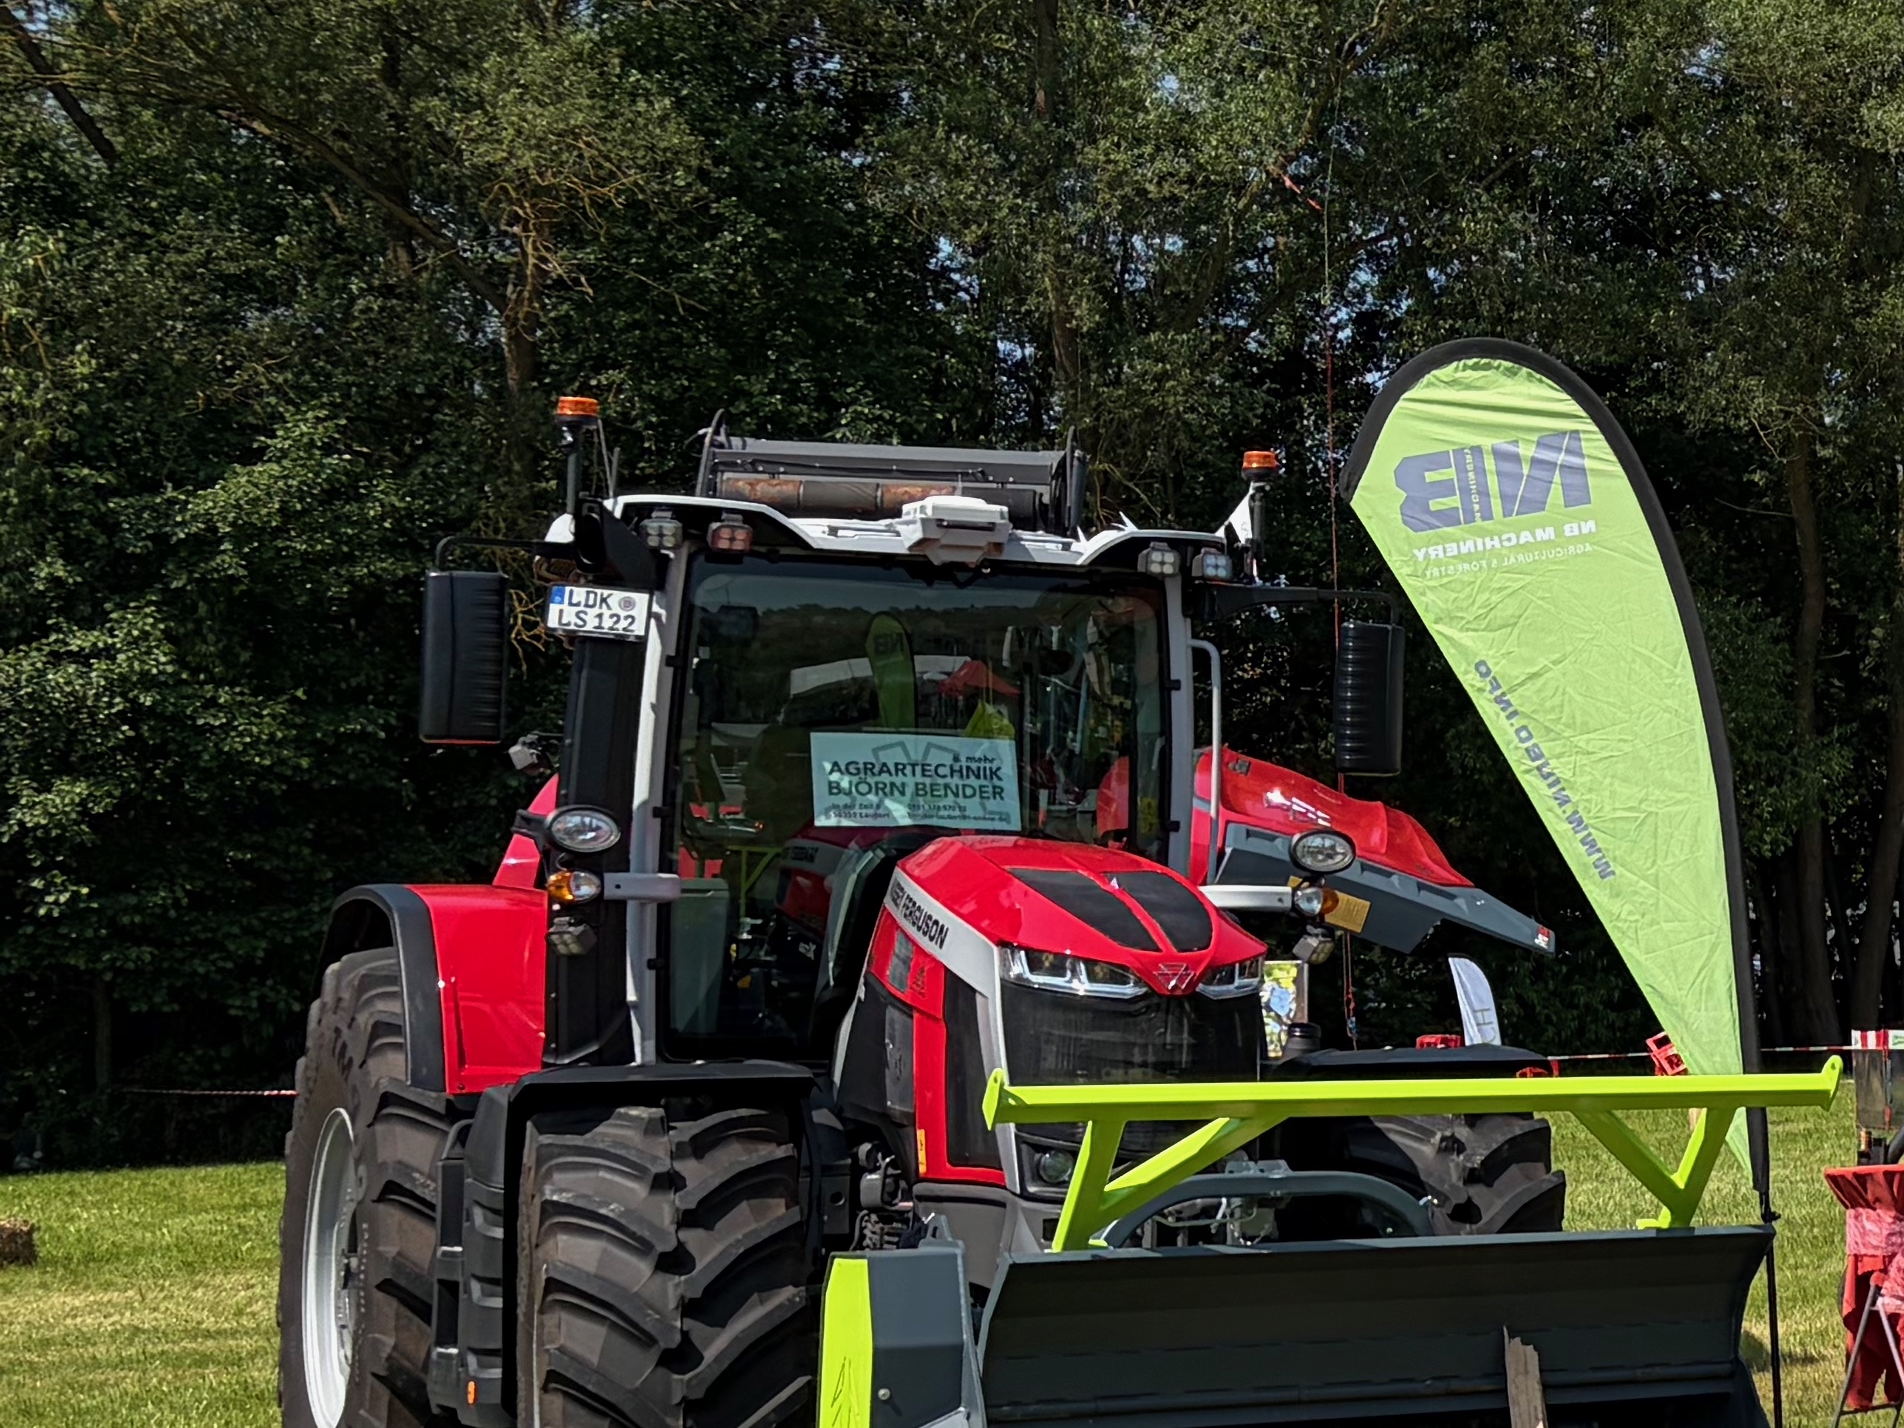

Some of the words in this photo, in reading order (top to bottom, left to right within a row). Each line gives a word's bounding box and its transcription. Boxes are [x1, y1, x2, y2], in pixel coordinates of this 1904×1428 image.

[567, 588, 614, 611] LDK
[557, 608, 589, 629] LS
[592, 612, 636, 633] 122
[828, 760, 1004, 782] AGRARTECHNIK
[965, 754, 997, 765] mehr
[827, 775, 907, 797] BJÖRN
[914, 781, 1006, 801] BENDER
[901, 893, 949, 951] FERGUSON
